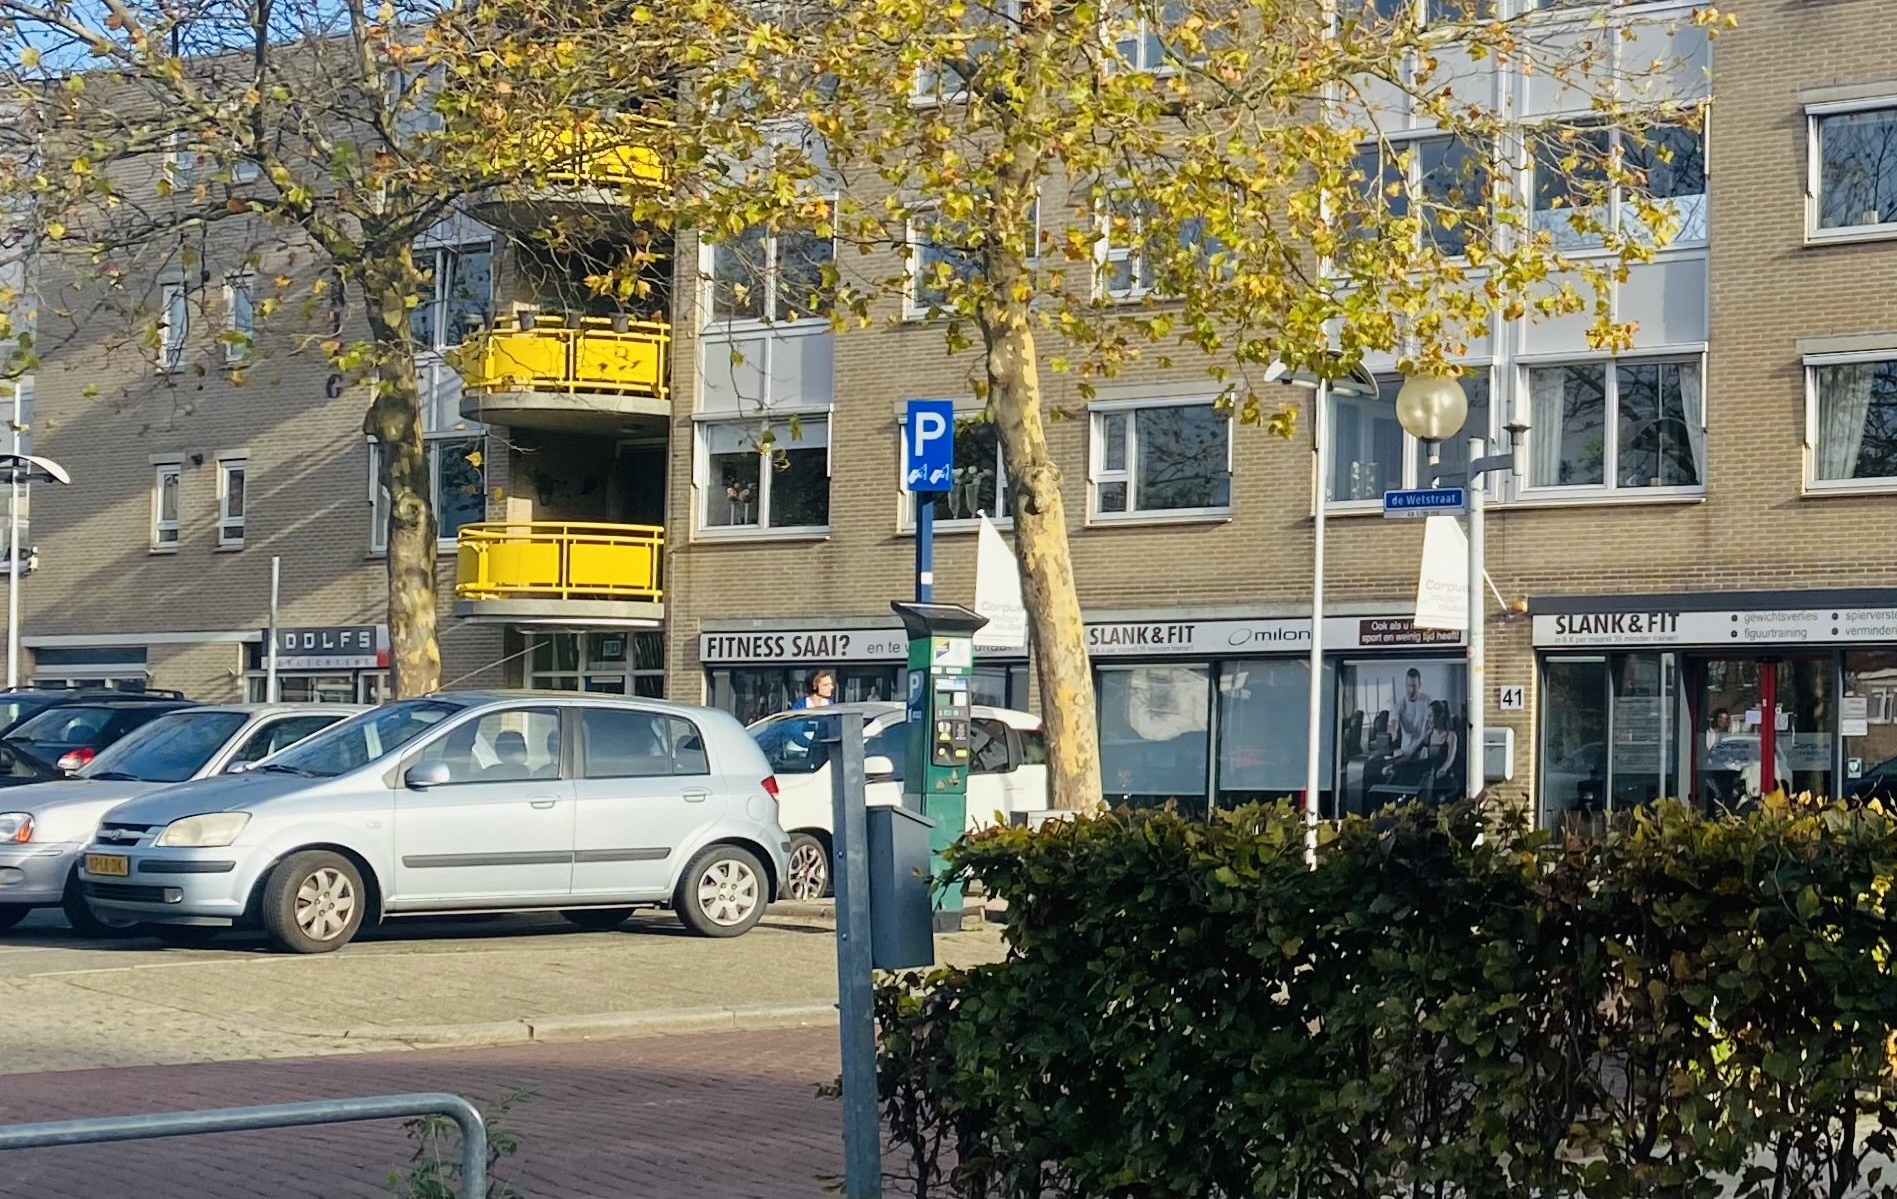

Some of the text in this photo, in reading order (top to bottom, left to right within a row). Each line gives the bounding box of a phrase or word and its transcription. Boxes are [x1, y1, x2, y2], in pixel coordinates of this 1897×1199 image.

[914, 412, 946, 456] P
[1392, 494, 1457, 506] de Wetstraat
[1744, 610, 1818, 624] gewichtsverlies
[1371, 621, 1387, 631] Ook
[277, 631, 371, 649] DOLFS
[1254, 627, 1311, 642] milon
[1361, 633, 1382, 643] sport
[1383, 633, 1394, 642] en
[1744, 627, 1808, 641] figuurtraining
[707, 636, 784, 658] FITNESS
[792, 634, 850, 657] SAAI?
[867, 643, 883, 654] en
[888, 642, 900, 653] te
[1503, 689, 1521, 706] 41
